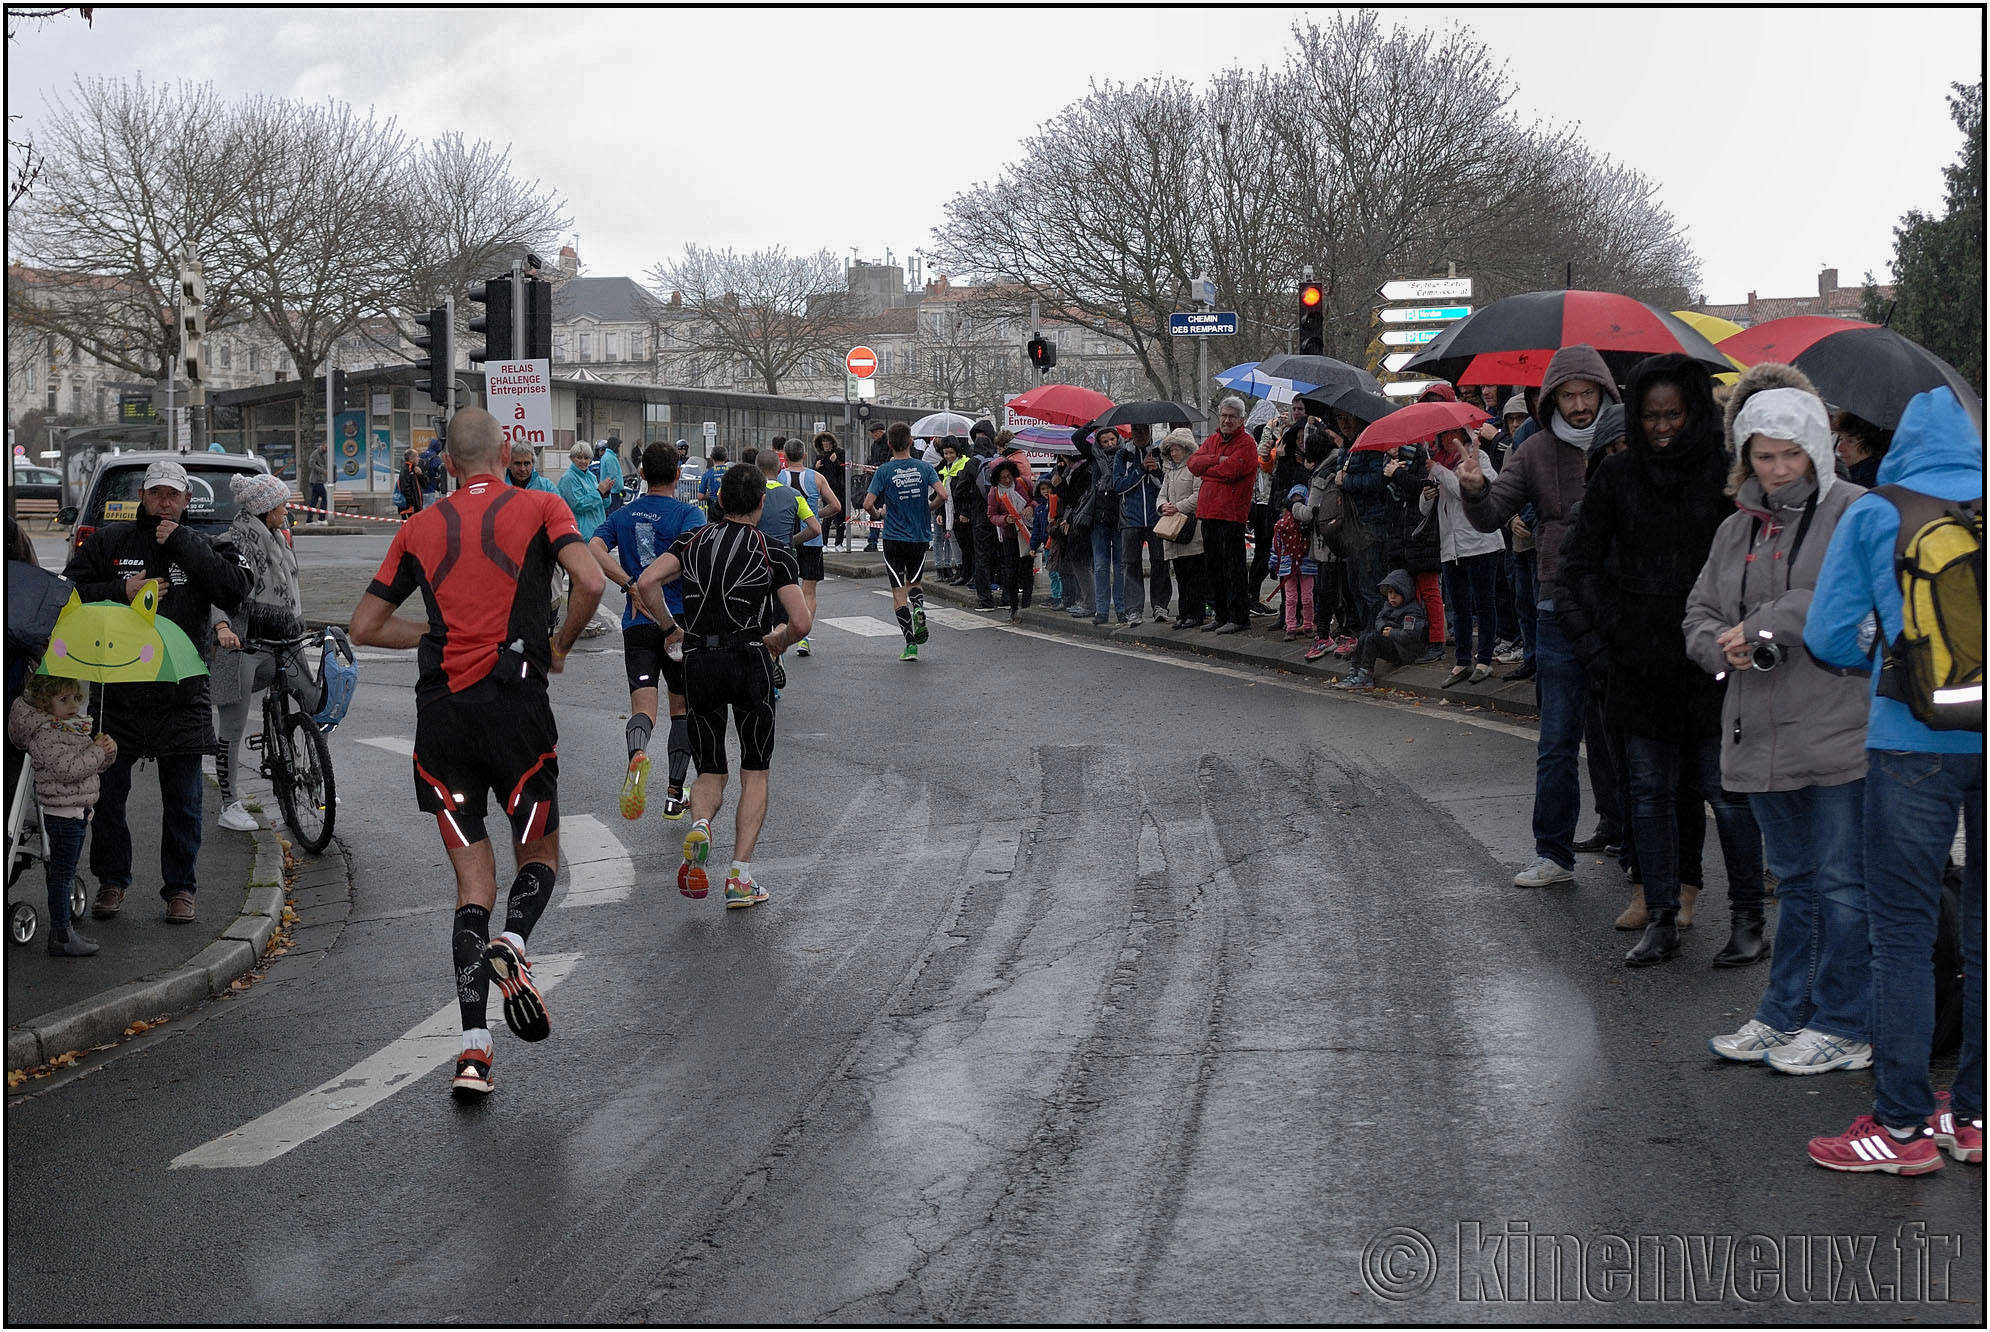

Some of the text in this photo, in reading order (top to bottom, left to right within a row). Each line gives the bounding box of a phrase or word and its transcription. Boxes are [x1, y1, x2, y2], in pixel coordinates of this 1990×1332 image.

[1188, 315, 1218, 323] CHEMIN
[1172, 325, 1234, 334] DES REMPARTS
[501, 364, 534, 374] RELAIS
[490, 375, 541, 385] CHALLENGE
[491, 385, 546, 396] Entreprises
[514, 403, 526, 420] à
